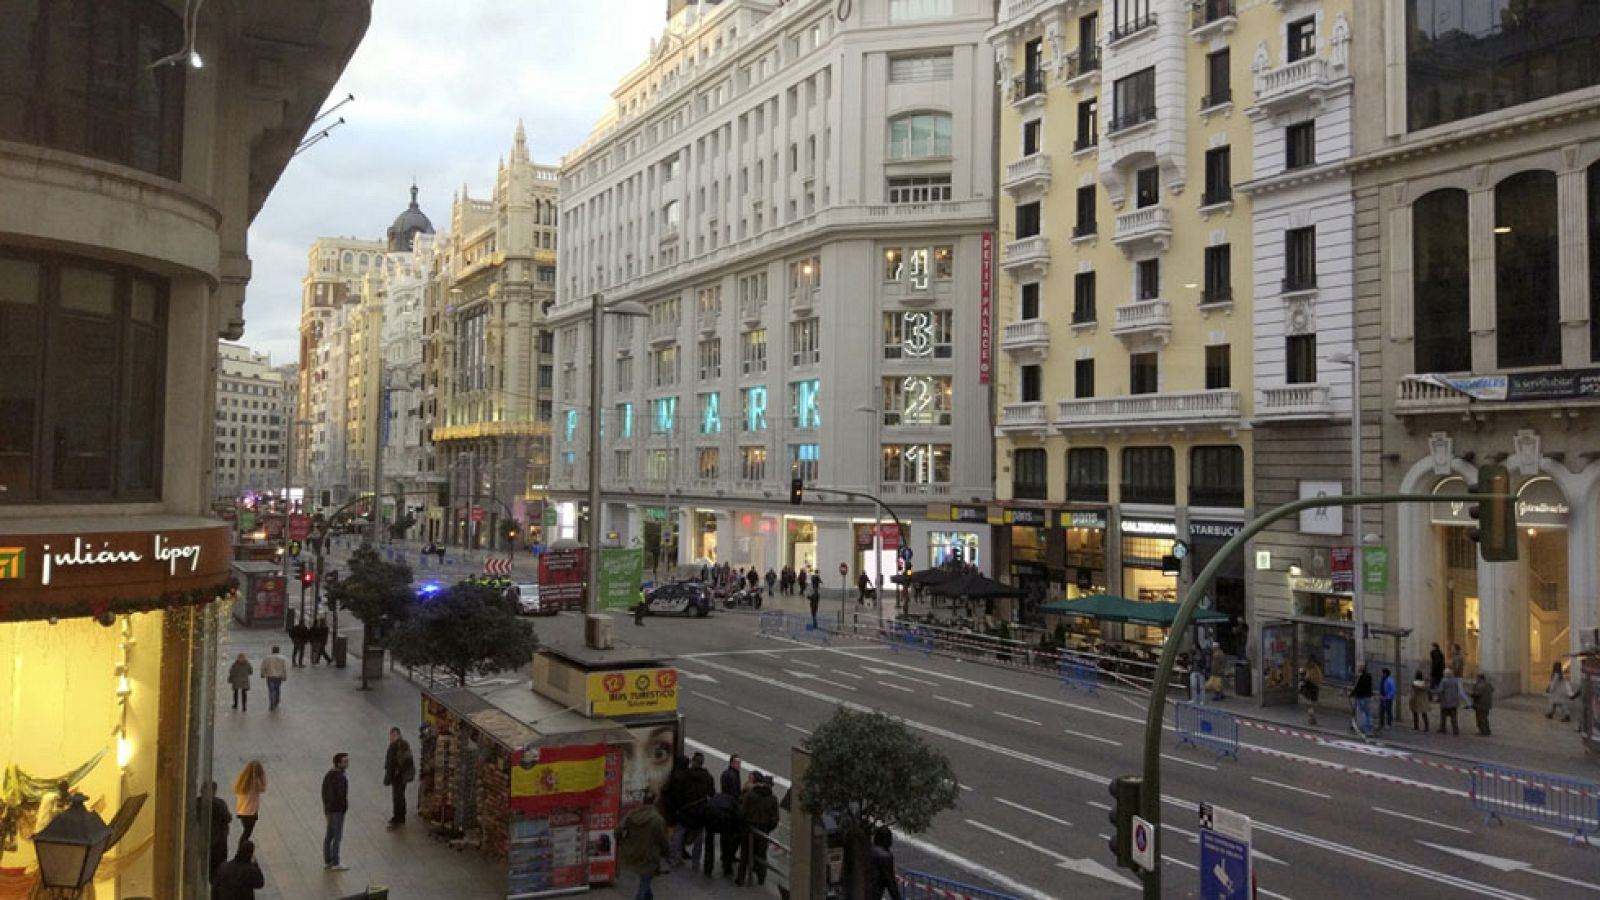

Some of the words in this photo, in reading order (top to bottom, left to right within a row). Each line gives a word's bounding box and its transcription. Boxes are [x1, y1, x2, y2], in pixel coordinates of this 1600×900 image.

[895, 248, 929, 290] 4
[983, 239, 991, 291] PETIT
[903, 311, 934, 357] 3
[982, 296, 991, 359] PALACE
[566, 379, 821, 442] PIMARK
[903, 376, 933, 424] 2
[905, 444, 933, 485] 1
[1072, 512, 1098, 525] pans
[41, 536, 143, 585] julián
[608, 692, 628, 702] BUS
